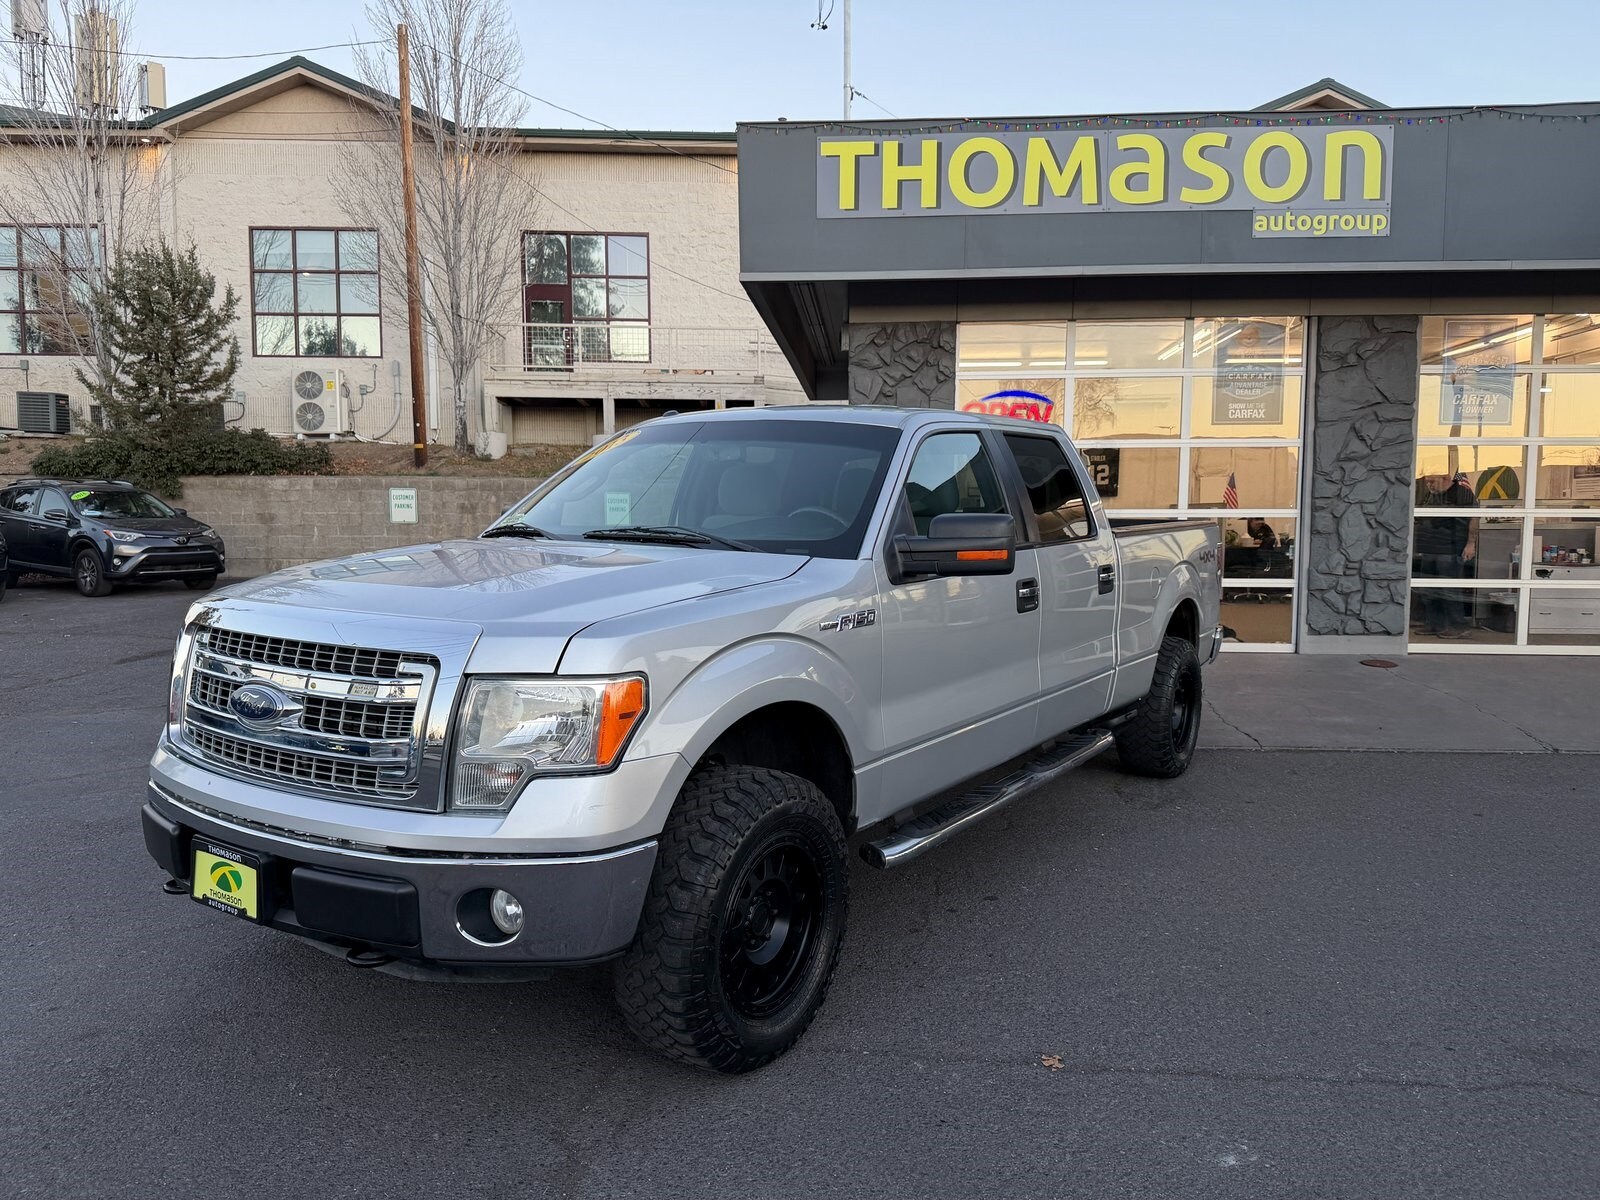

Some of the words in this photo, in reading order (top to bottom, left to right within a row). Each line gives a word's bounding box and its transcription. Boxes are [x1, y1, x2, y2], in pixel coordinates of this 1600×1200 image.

[1254, 211, 1388, 235] autogroup
[1453, 394, 1499, 405] CARFAX
[1228, 409, 1266, 419] CARFAX
[1458, 406, 1494, 414] 1-OWNER
[236, 691, 266, 714] Ford
[208, 900, 238, 915] autogroup
